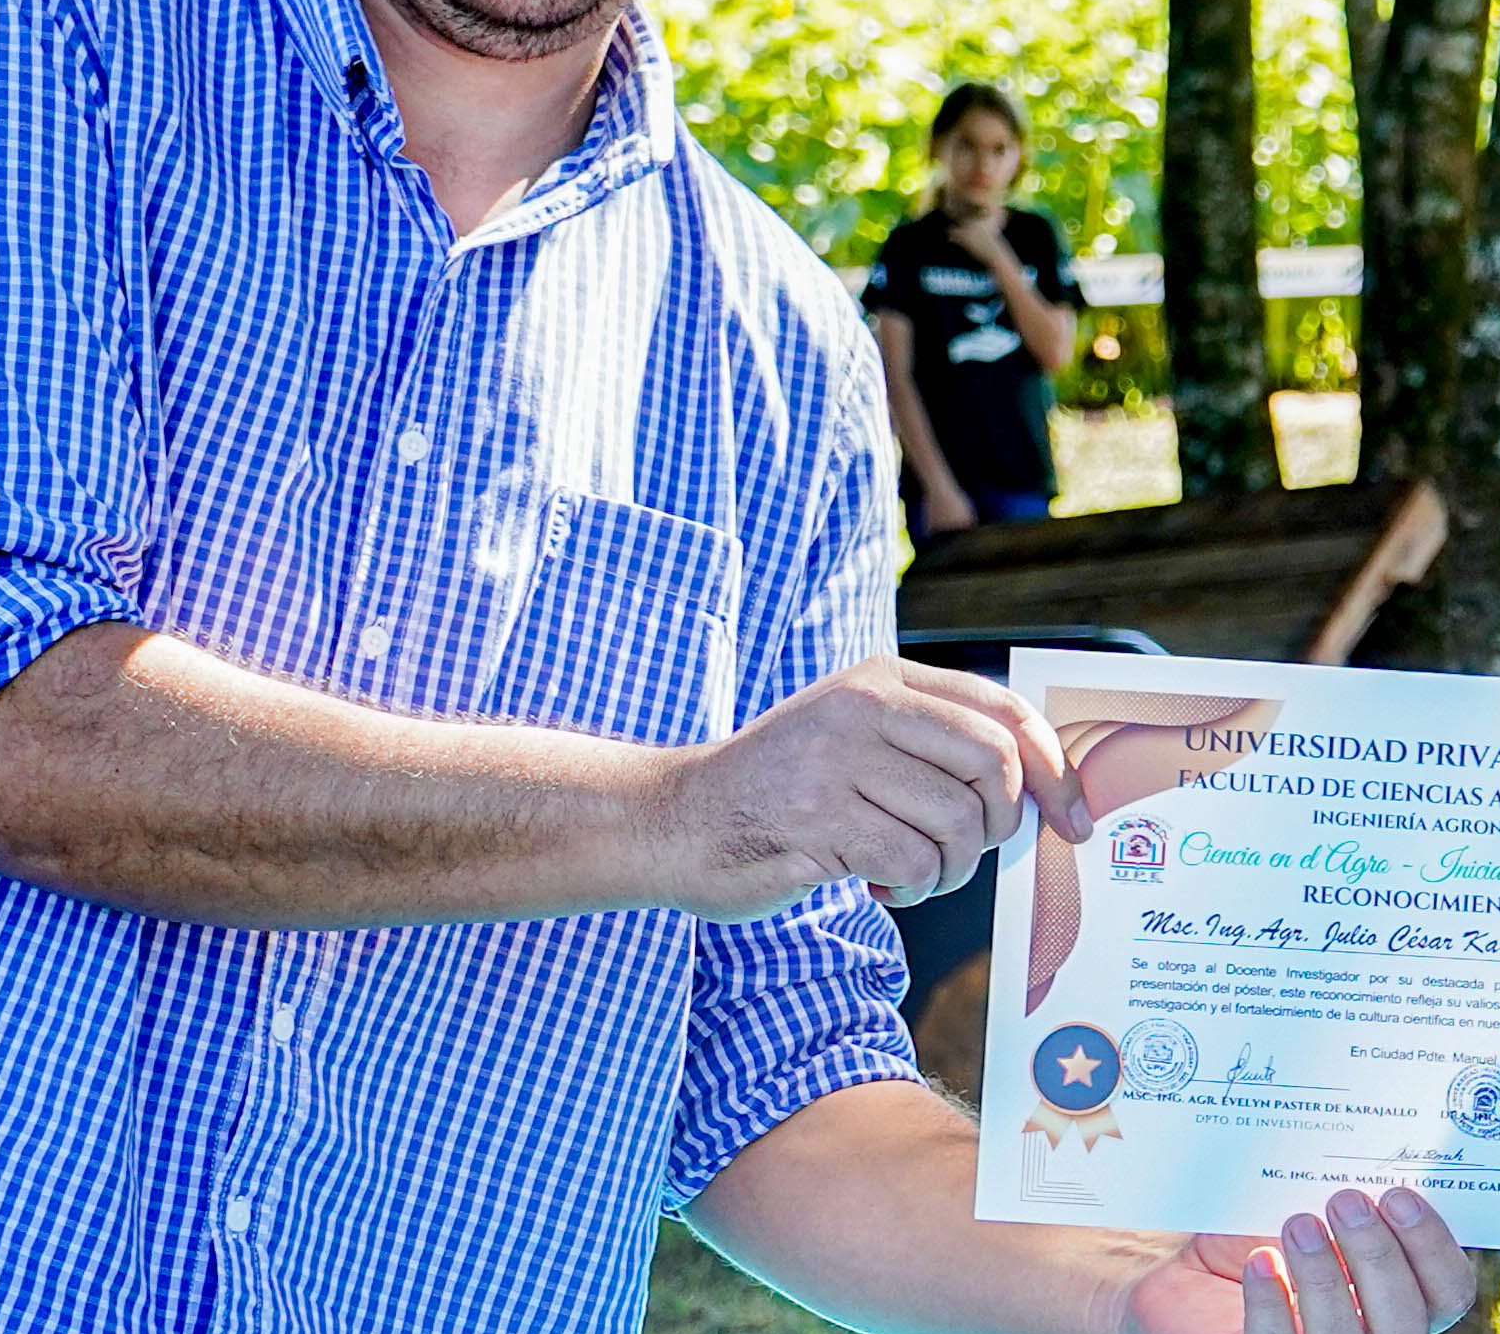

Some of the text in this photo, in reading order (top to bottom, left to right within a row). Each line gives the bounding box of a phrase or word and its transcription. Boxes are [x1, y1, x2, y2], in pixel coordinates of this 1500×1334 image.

[1184, 727, 1407, 764] UNIVERSIDAD
[1178, 771, 1315, 797] FACULTAD
[1321, 779, 1356, 799] DE
[1362, 781, 1483, 807] CIENCIAS
[1312, 811, 1427, 831] INGENIERÍA
[1179, 831, 1262, 866] Ciencia
[1269, 852, 1292, 868] en
[1300, 844, 1322, 870] el
[1325, 840, 1389, 884] Agro
[1141, 910, 1198, 936] Msc.
[1205, 913, 1251, 945] Ing.
[1254, 918, 1308, 949] Agr.
[1322, 921, 1378, 953] Julio
[1388, 924, 1453, 952] César
[1131, 957, 1148, 970] Se
[1157, 959, 1196, 976] otorga
[1205, 962, 1217, 974] al
[1225, 963, 1277, 978] Docente
[1285, 966, 1360, 984] Investigador
[1369, 974, 1389, 986] por
[1398, 976, 1412, 986] su
[1422, 974, 1484, 990] destacada
[1129, 979, 1208, 993] presentación
[1212, 981, 1231, 995] del
[1234, 983, 1276, 1000] póster,
[1280, 986, 1306, 999] este
[1310, 990, 1401, 1005] reconocimiento
[1406, 993, 1442, 1009] refleja
[1446, 998, 1461, 1008] su
[1128, 995, 1207, 1012] investigación
[1221, 1000, 1232, 1013] el
[1235, 1001, 1323, 1018] fortalecimiento
[1326, 1006, 1342, 1020] de
[1345, 1008, 1356, 1020] la
[1359, 1009, 1400, 1023] cultura
[1403, 1011, 1455, 1026] científica
[1459, 1017, 1474, 1028] en
[1350, 1045, 1367, 1058] En
[1371, 1046, 1414, 1061] Ciudad
[1452, 1051, 1497, 1066] Manuel
[1157, 1091, 1186, 1104] ING.
[1222, 1094, 1271, 1108] EVELYN
[1274, 1097, 1321, 1111] PASTER
[1324, 1100, 1342, 1113] DE
[1345, 1102, 1418, 1117] KARAJALLO
[1235, 1115, 1251, 1126] DE
[1255, 1116, 1356, 1132] INVESTIGACIÓN
[1262, 1167, 1286, 1180] MG.
[1290, 1168, 1318, 1181] ING.
[1355, 1172, 1397, 1186] MABEL
[1414, 1171, 1456, 1189] LÓPEZ
[1458, 1178, 1476, 1191] DE
